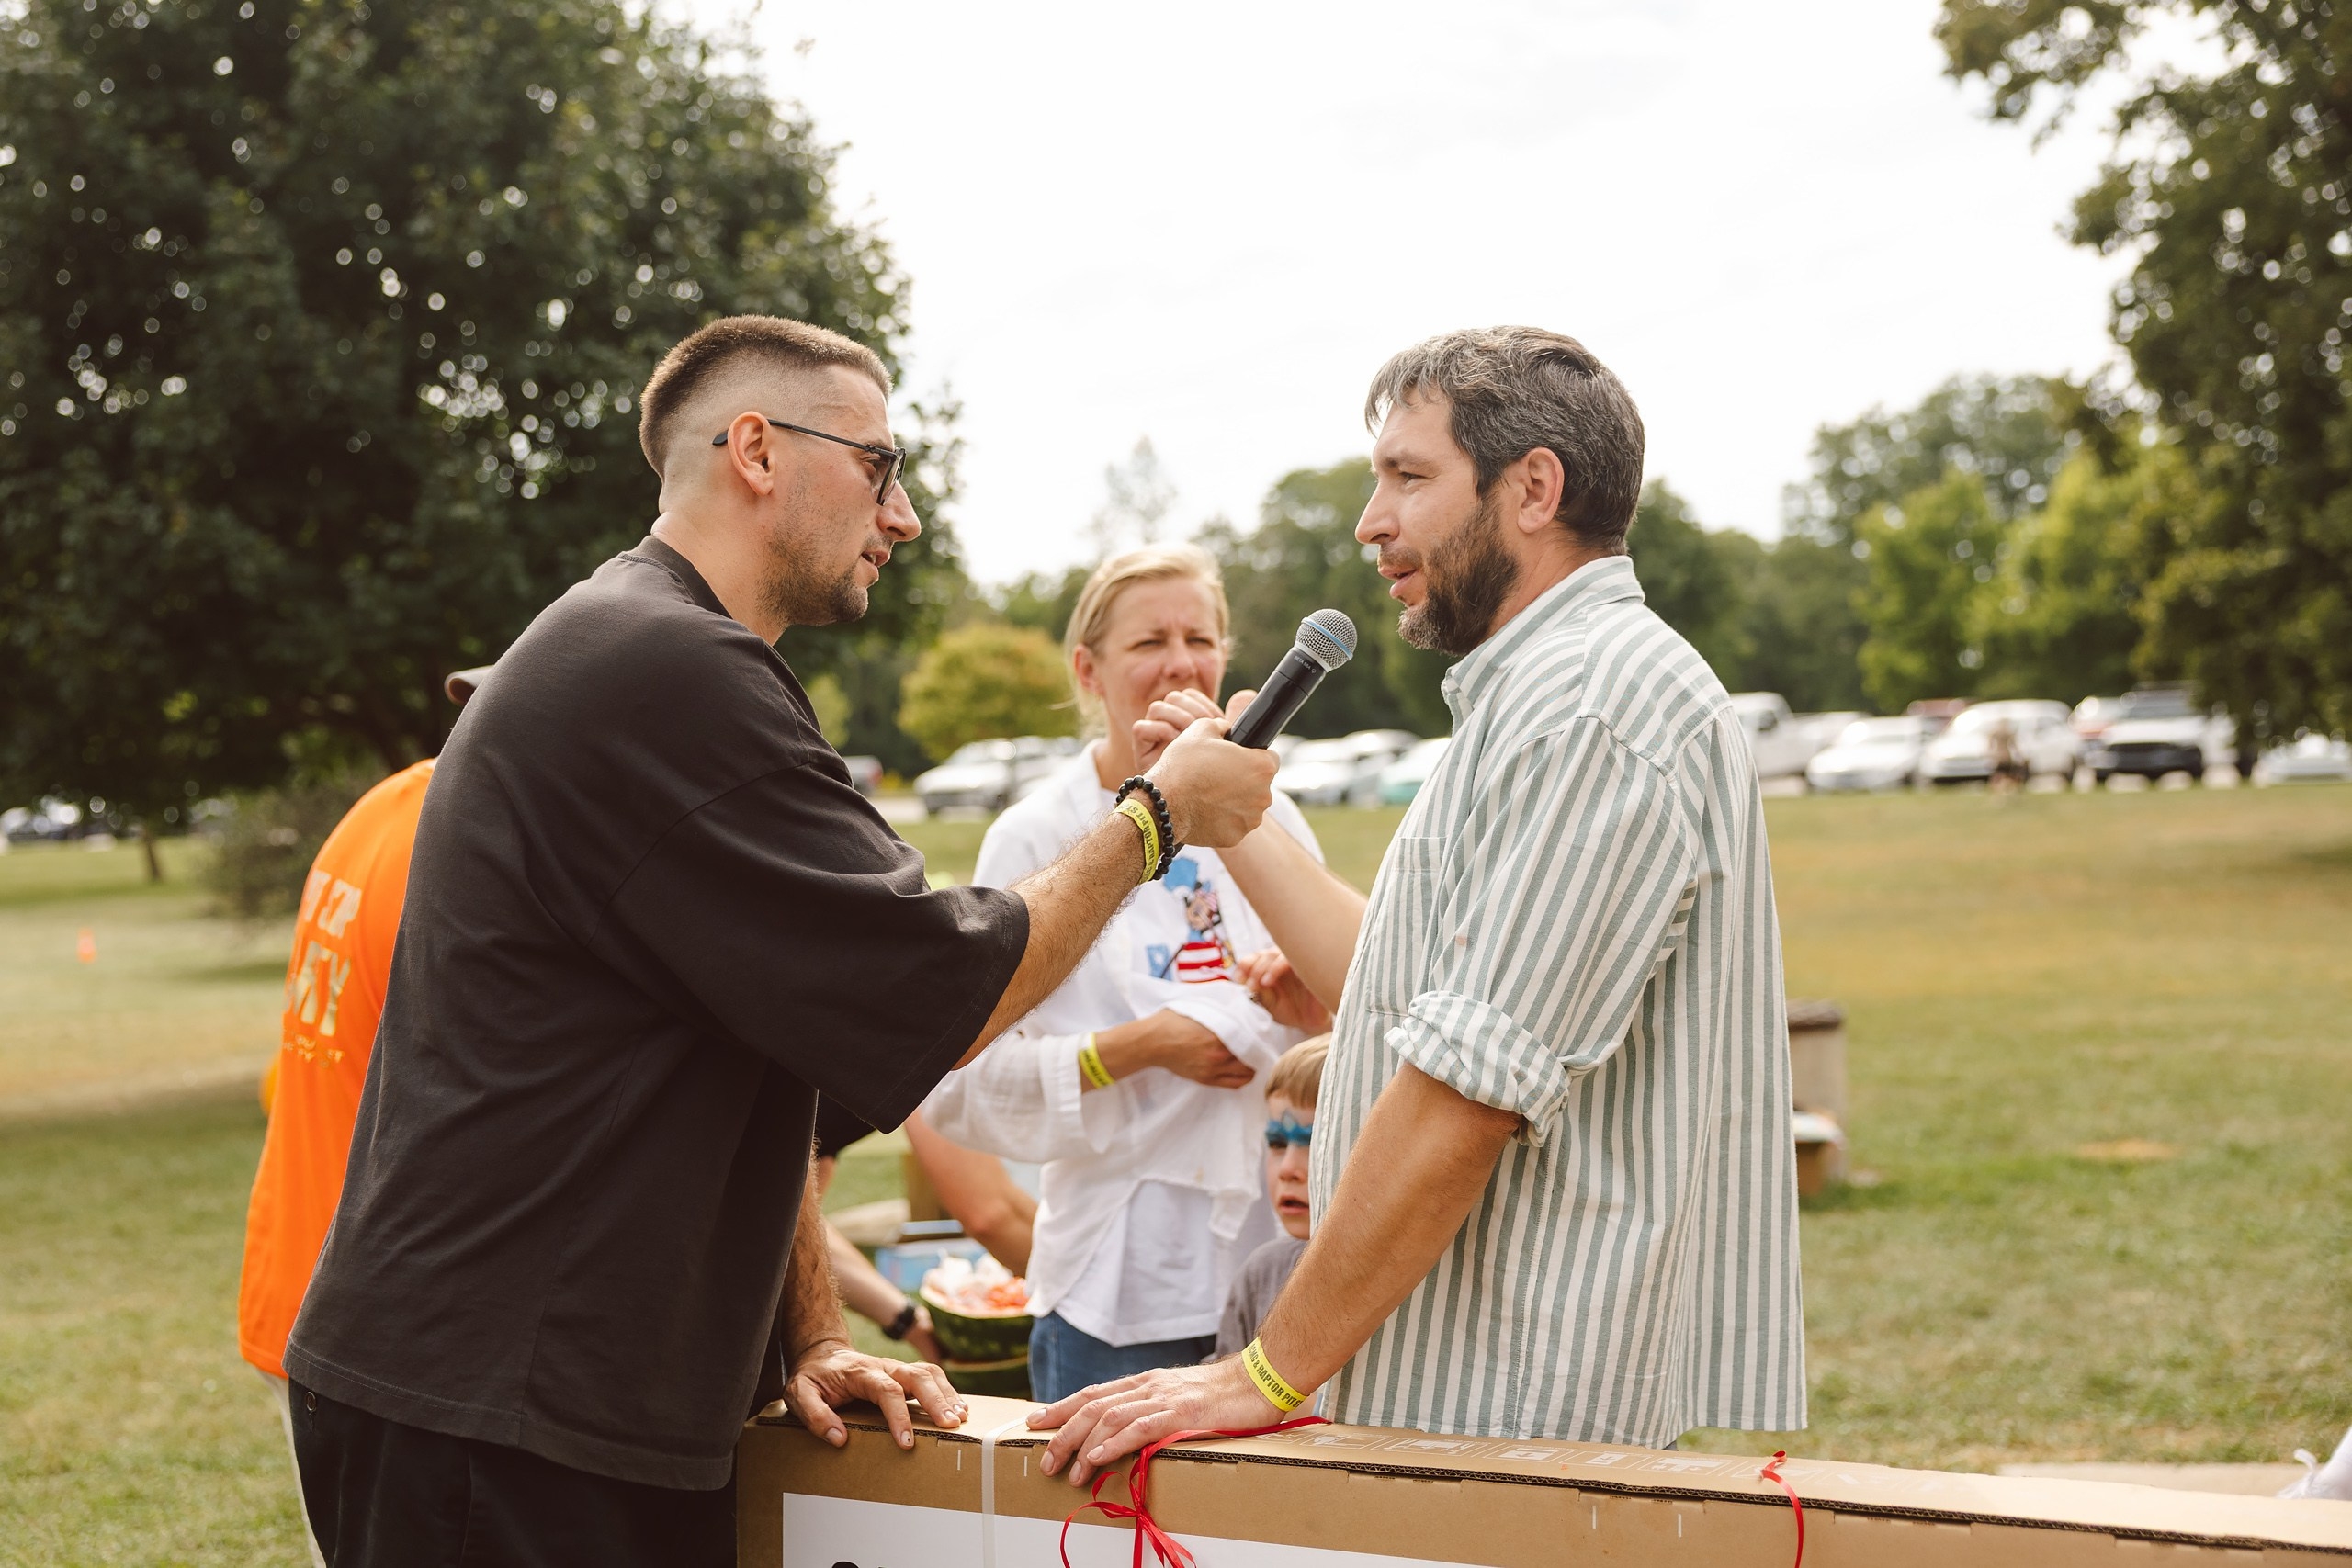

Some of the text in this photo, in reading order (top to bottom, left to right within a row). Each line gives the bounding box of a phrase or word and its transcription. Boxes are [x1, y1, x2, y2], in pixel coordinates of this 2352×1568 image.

[1136, 813, 1148, 825] PIT
[1144, 826, 1155, 860] RAPTOR
[1253, 1359, 1260, 1369] &
[1256, 1364, 1285, 1397] RAPTOR
[1282, 1393, 1296, 1405] PIT
